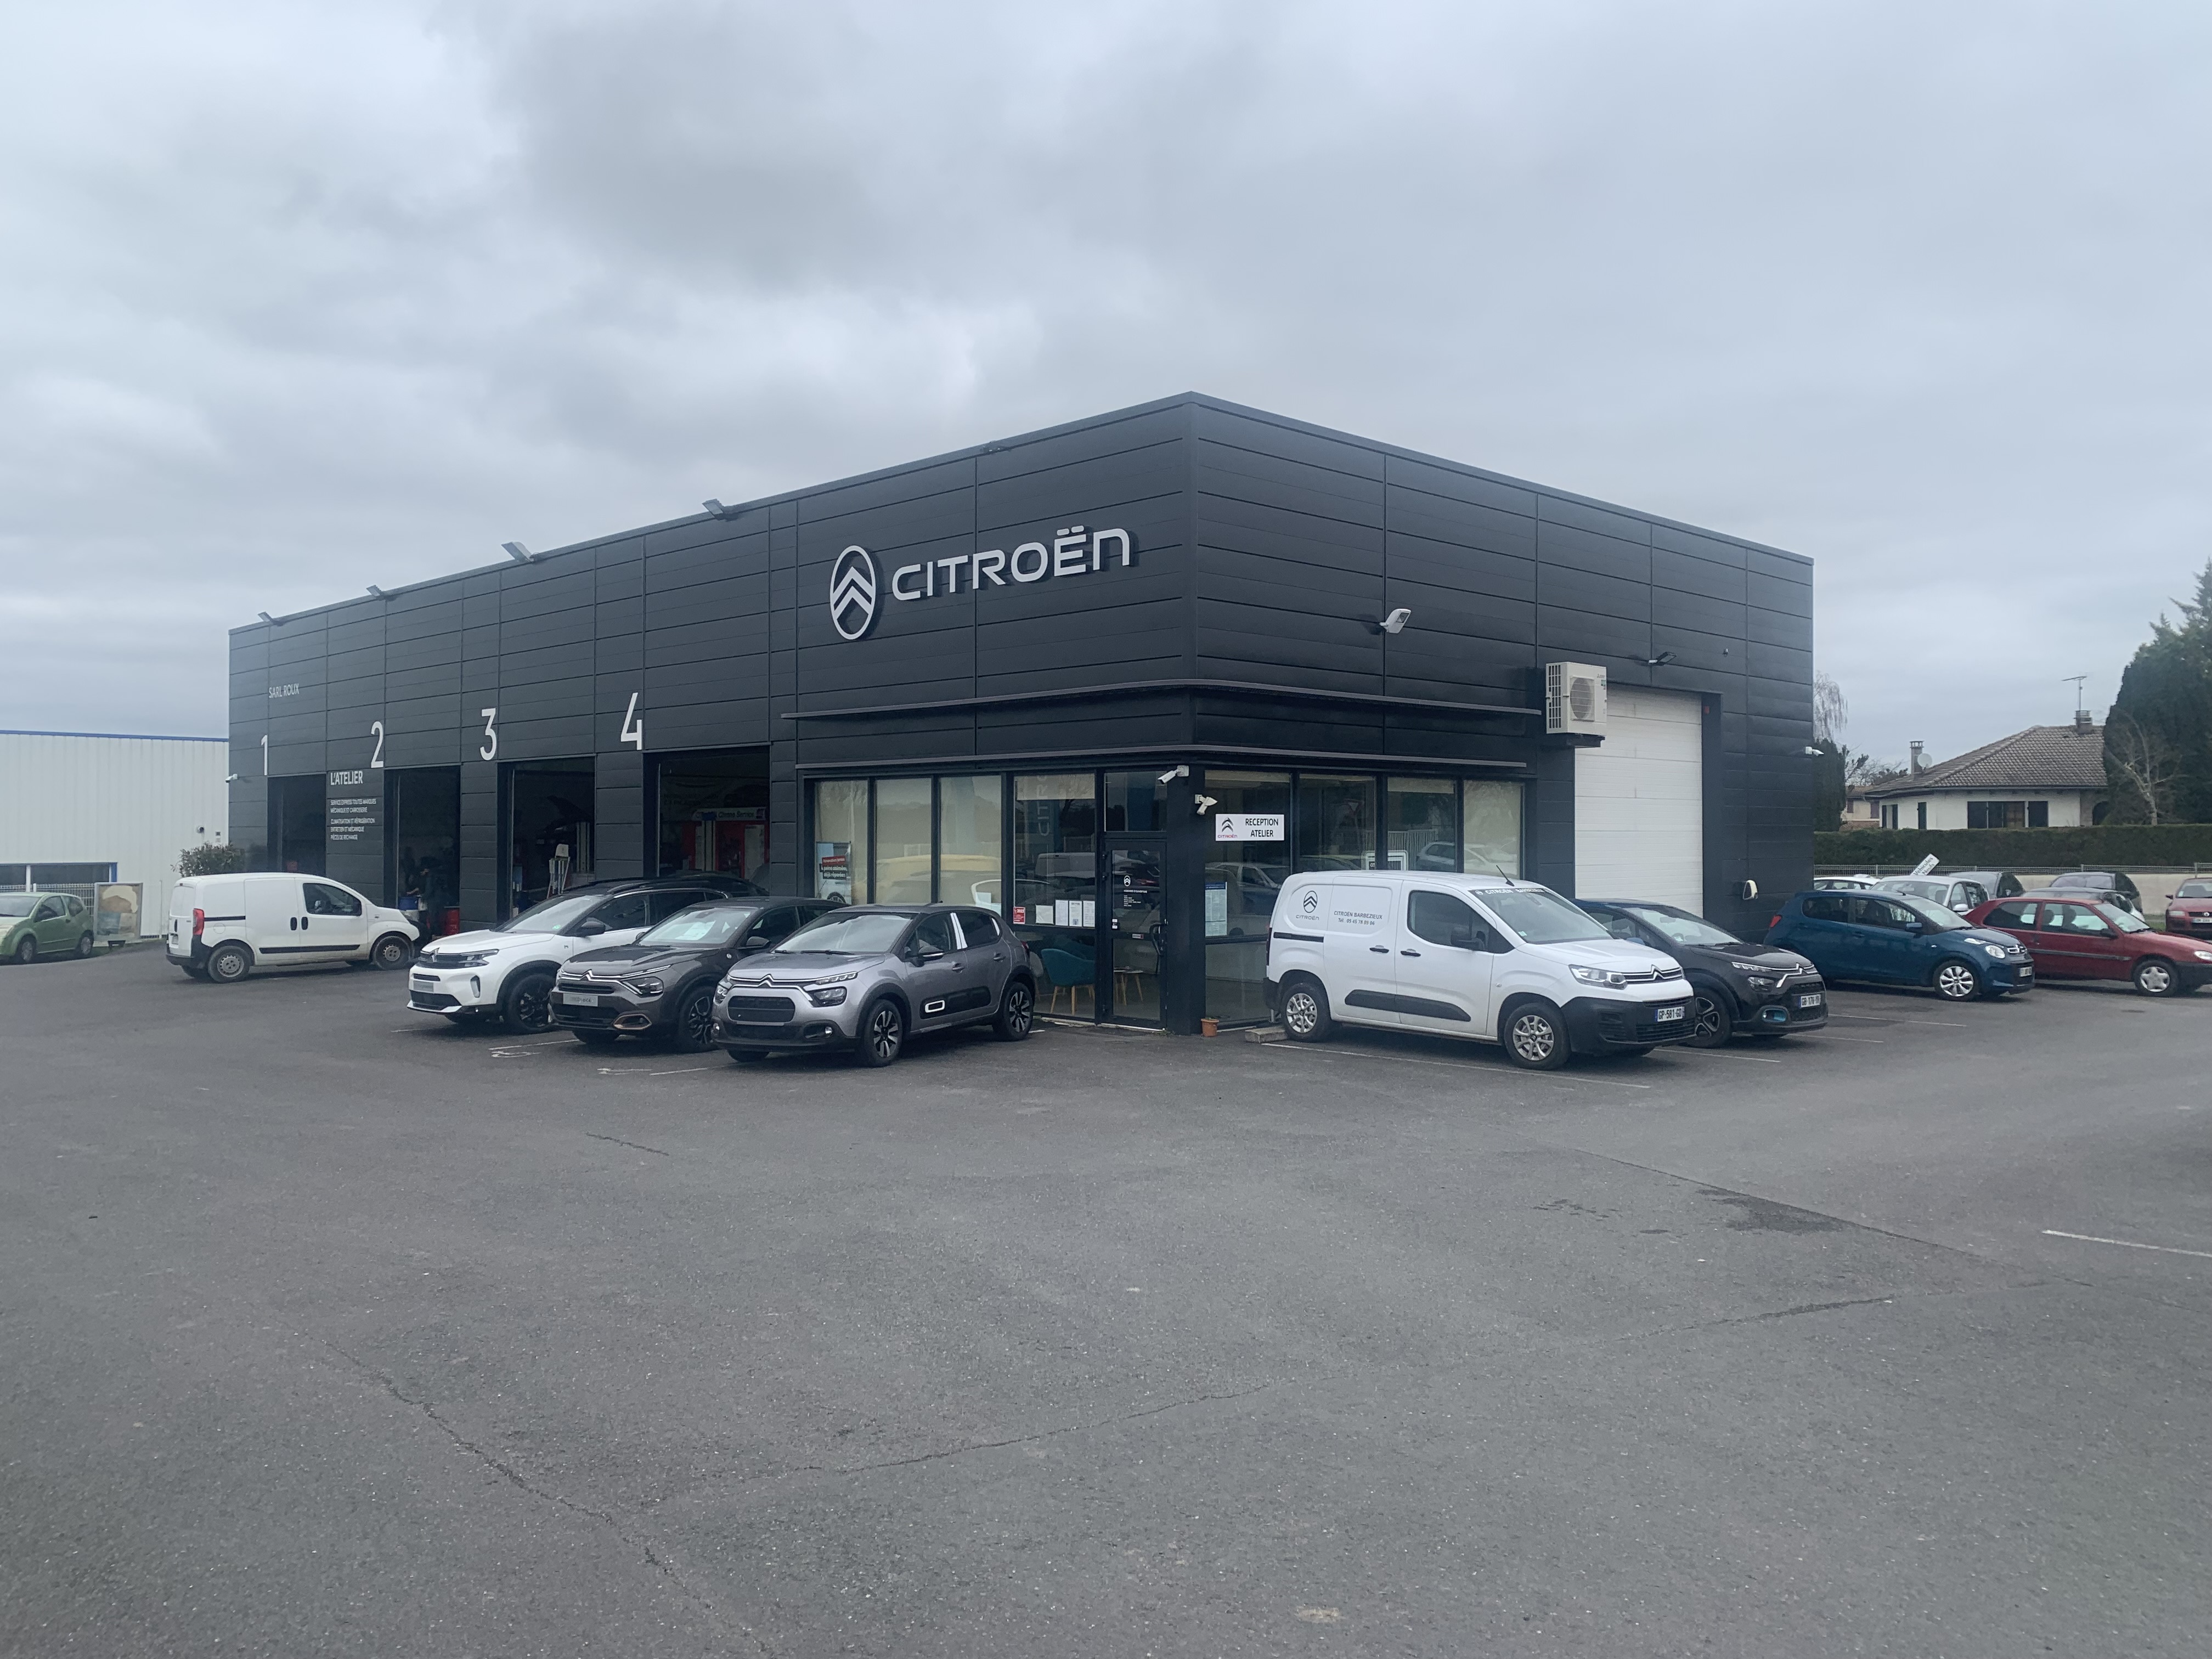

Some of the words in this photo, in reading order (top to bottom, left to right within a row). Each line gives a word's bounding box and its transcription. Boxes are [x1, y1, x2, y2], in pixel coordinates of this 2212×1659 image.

[892, 525, 1130, 601] CITROËN
[269, 686, 282, 698] SARL
[284, 683, 299, 696] ROUX
[370, 721, 383, 768] 2
[479, 707, 496, 760] 3
[620, 692, 642, 751] 4
[261, 735, 268, 776] 1
[330, 770, 363, 786] L'ATELIER
